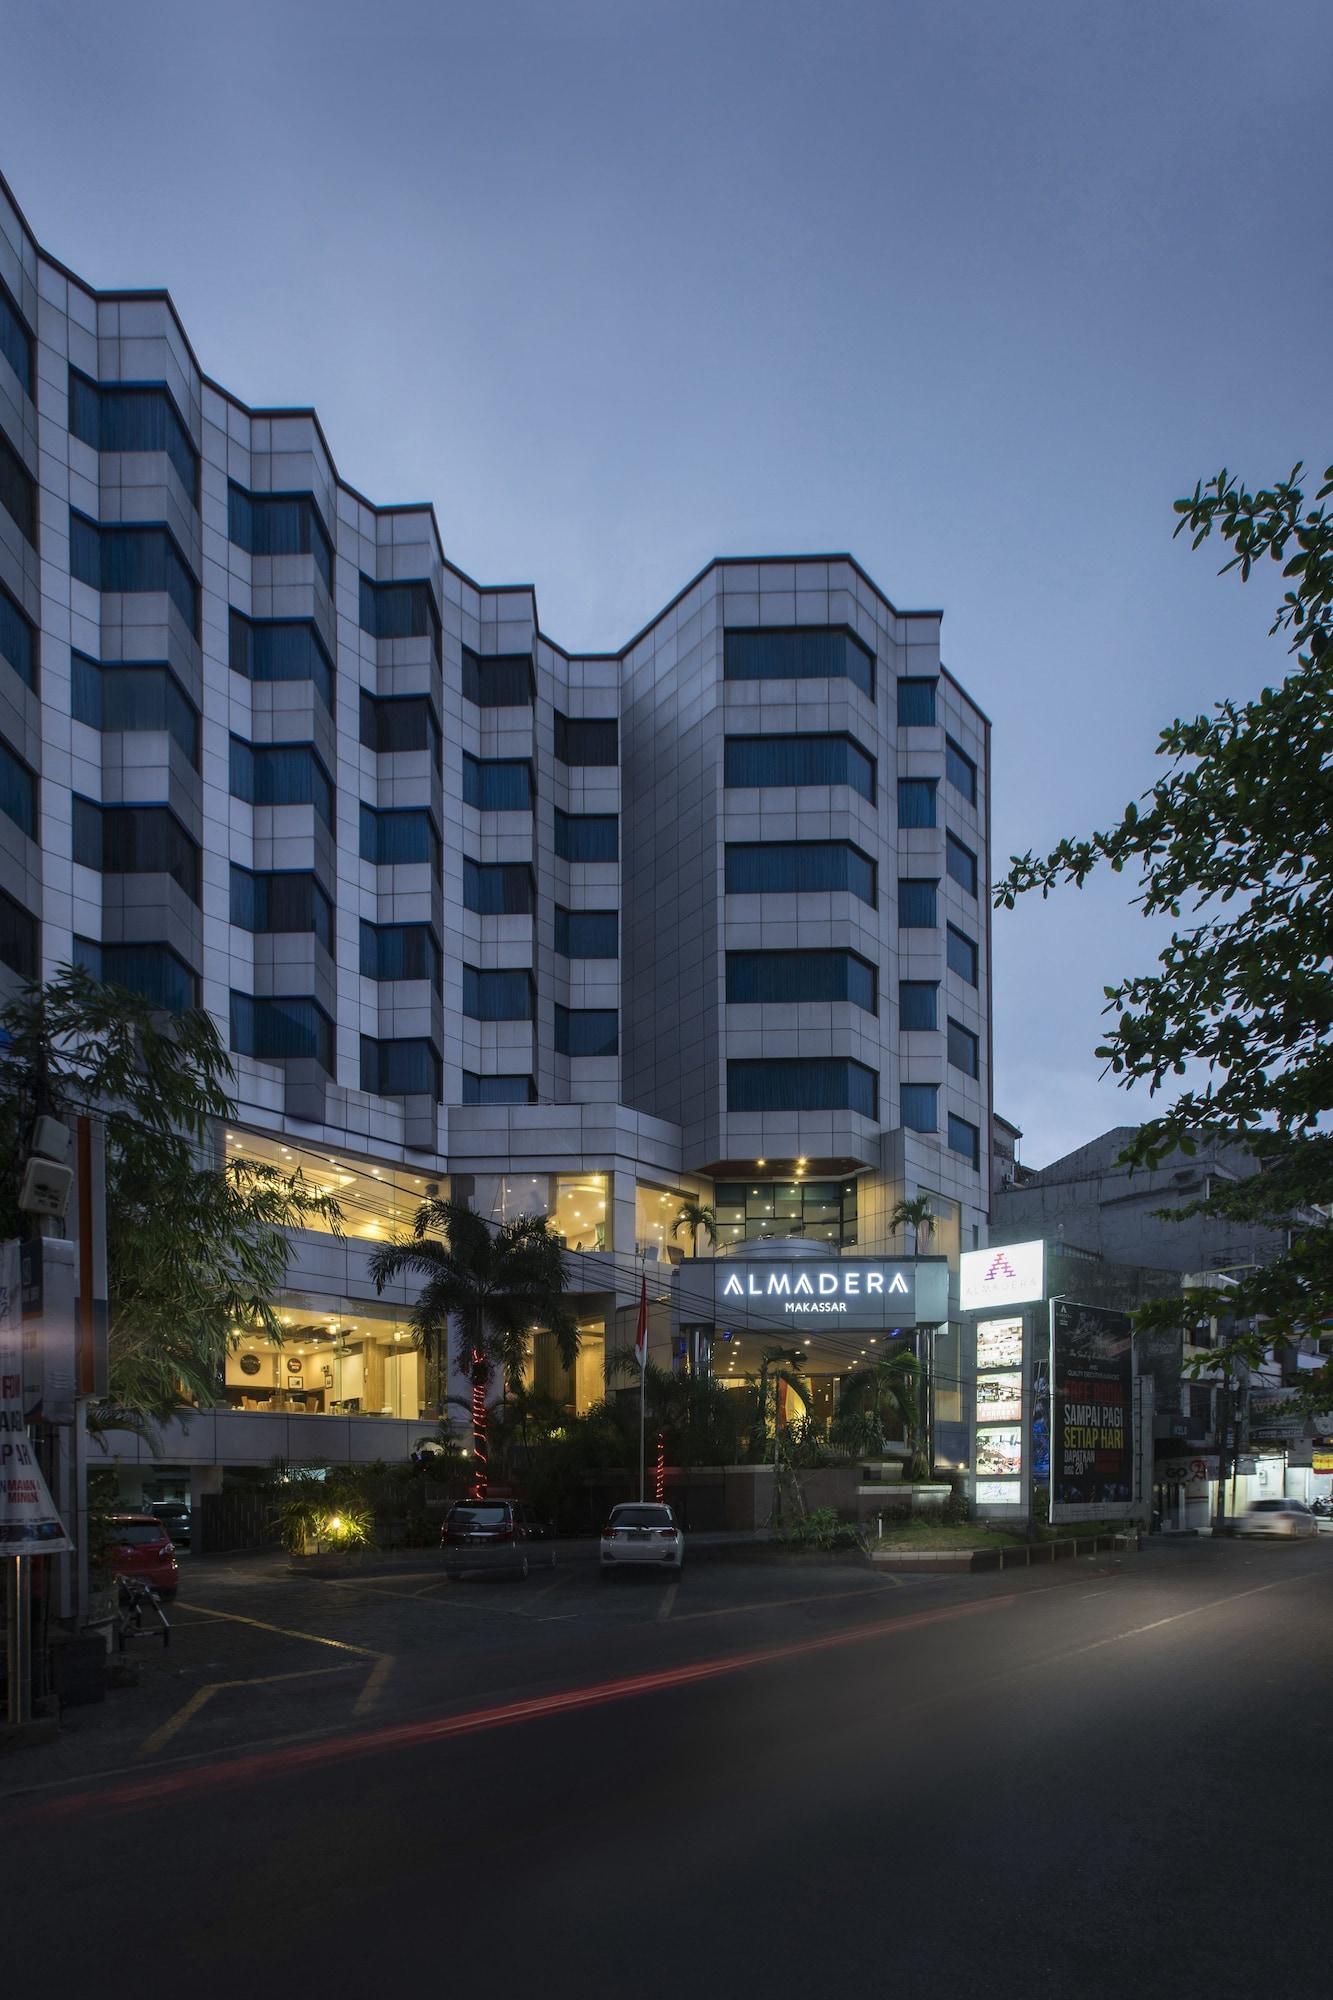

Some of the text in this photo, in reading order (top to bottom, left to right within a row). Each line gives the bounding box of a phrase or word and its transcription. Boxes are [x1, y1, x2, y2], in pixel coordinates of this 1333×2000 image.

[724, 1273, 909, 1295] ALMADERA
[785, 1302, 847, 1313] MAKASSAR
[1064, 1404, 1123, 1428] SAMPAI PAGI
[1064, 1427, 1124, 1449] SETIAP HARI
[1064, 1450, 1095, 1463] DAPATKAN
